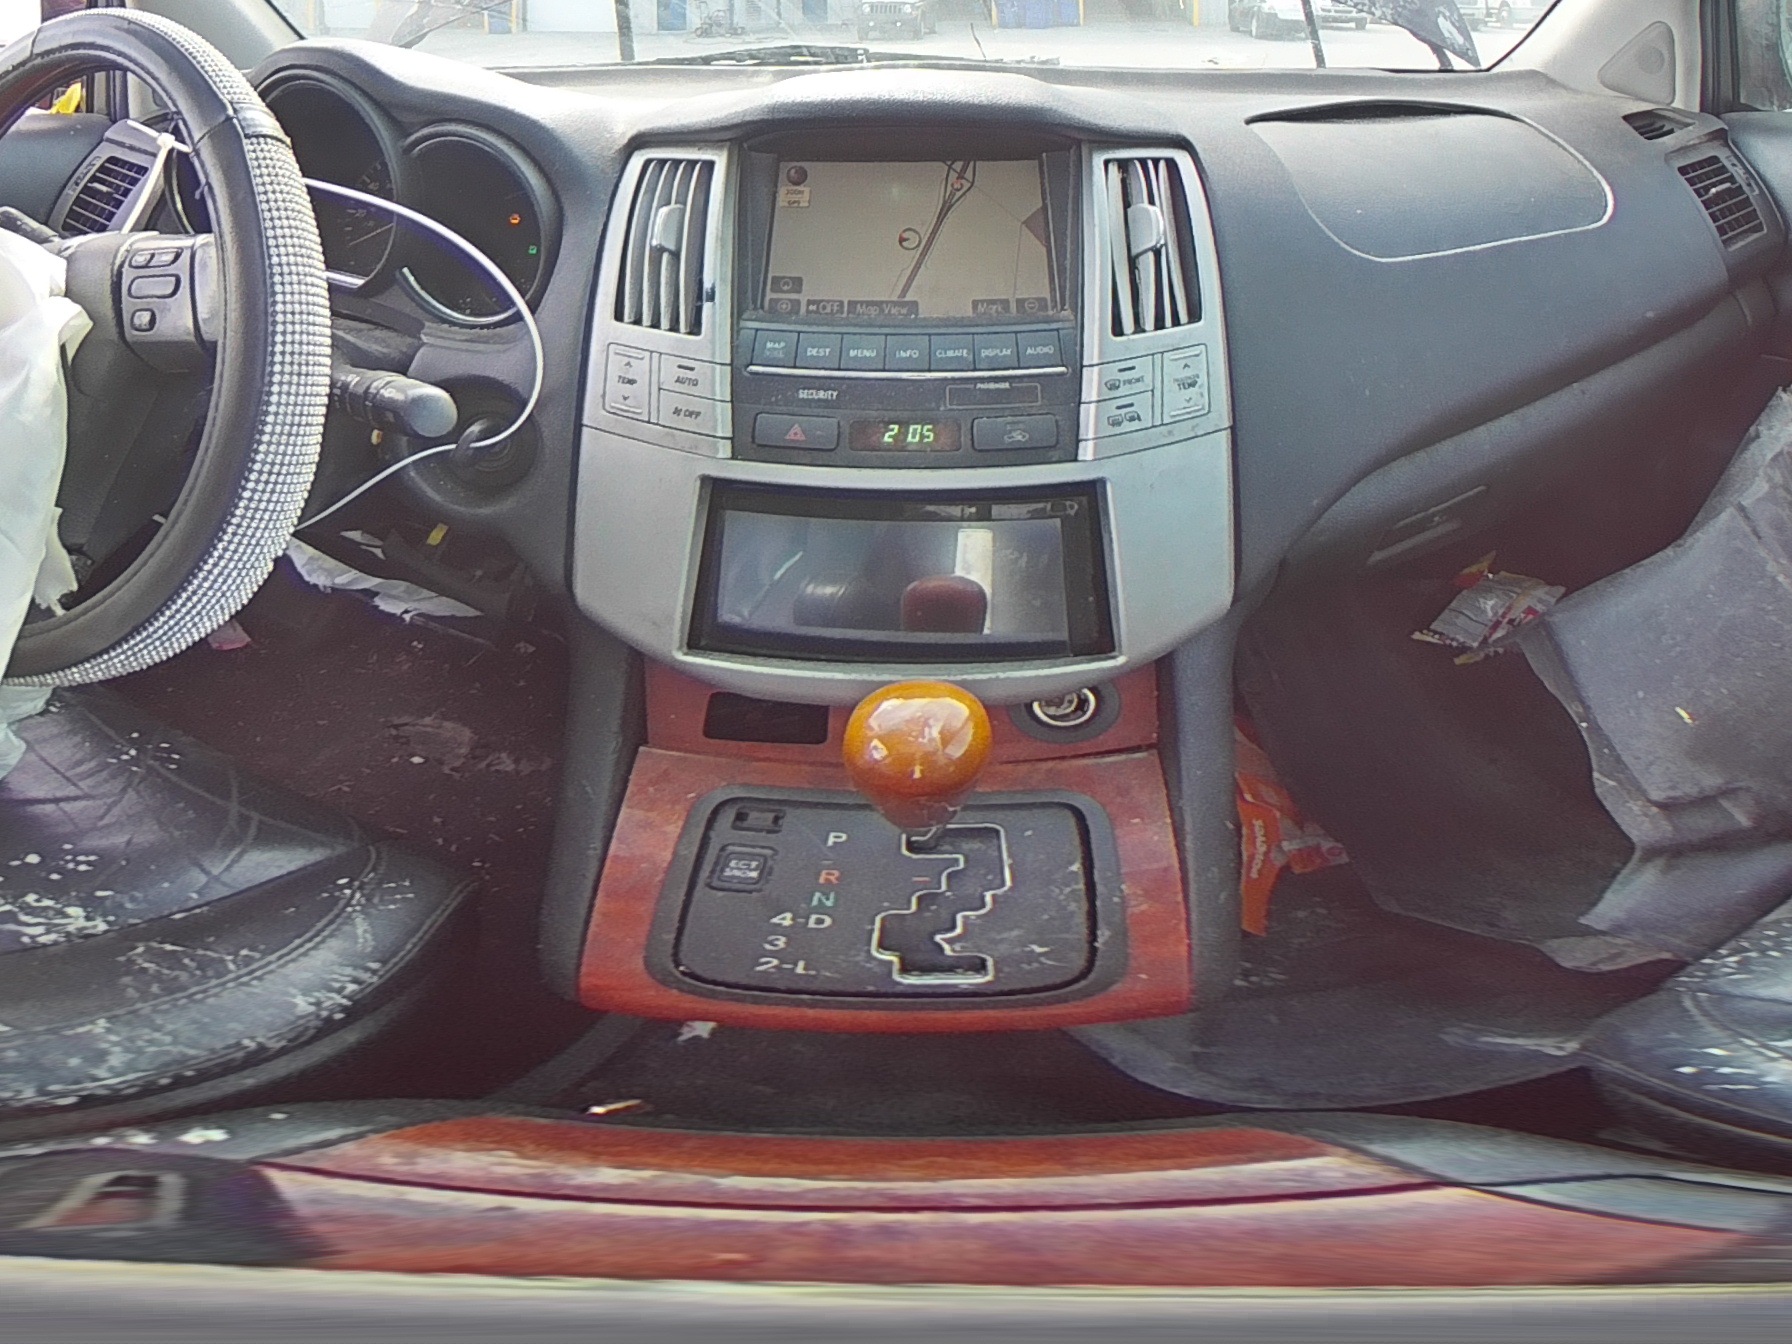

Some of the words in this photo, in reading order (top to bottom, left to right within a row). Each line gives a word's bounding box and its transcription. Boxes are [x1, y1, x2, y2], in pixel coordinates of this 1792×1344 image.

[819, 301, 840, 314] OFF
[857, 303, 879, 316] Map
[883, 302, 908, 315] View
[977, 301, 1004, 314] Mark
[807, 347, 831, 357] DEST
[849, 348, 877, 357] MENU
[1026, 345, 1055, 355] AUDIO
[617, 374, 638, 386] TEMP
[674, 375, 699, 387] AUTO
[798, 389, 839, 400] SECURITY
[683, 408, 702, 420] OFF
[826, 831, 848, 847] P
[818, 869, 841, 885] R
[811, 891, 836, 907] N
[762, 935, 788, 951] 3
